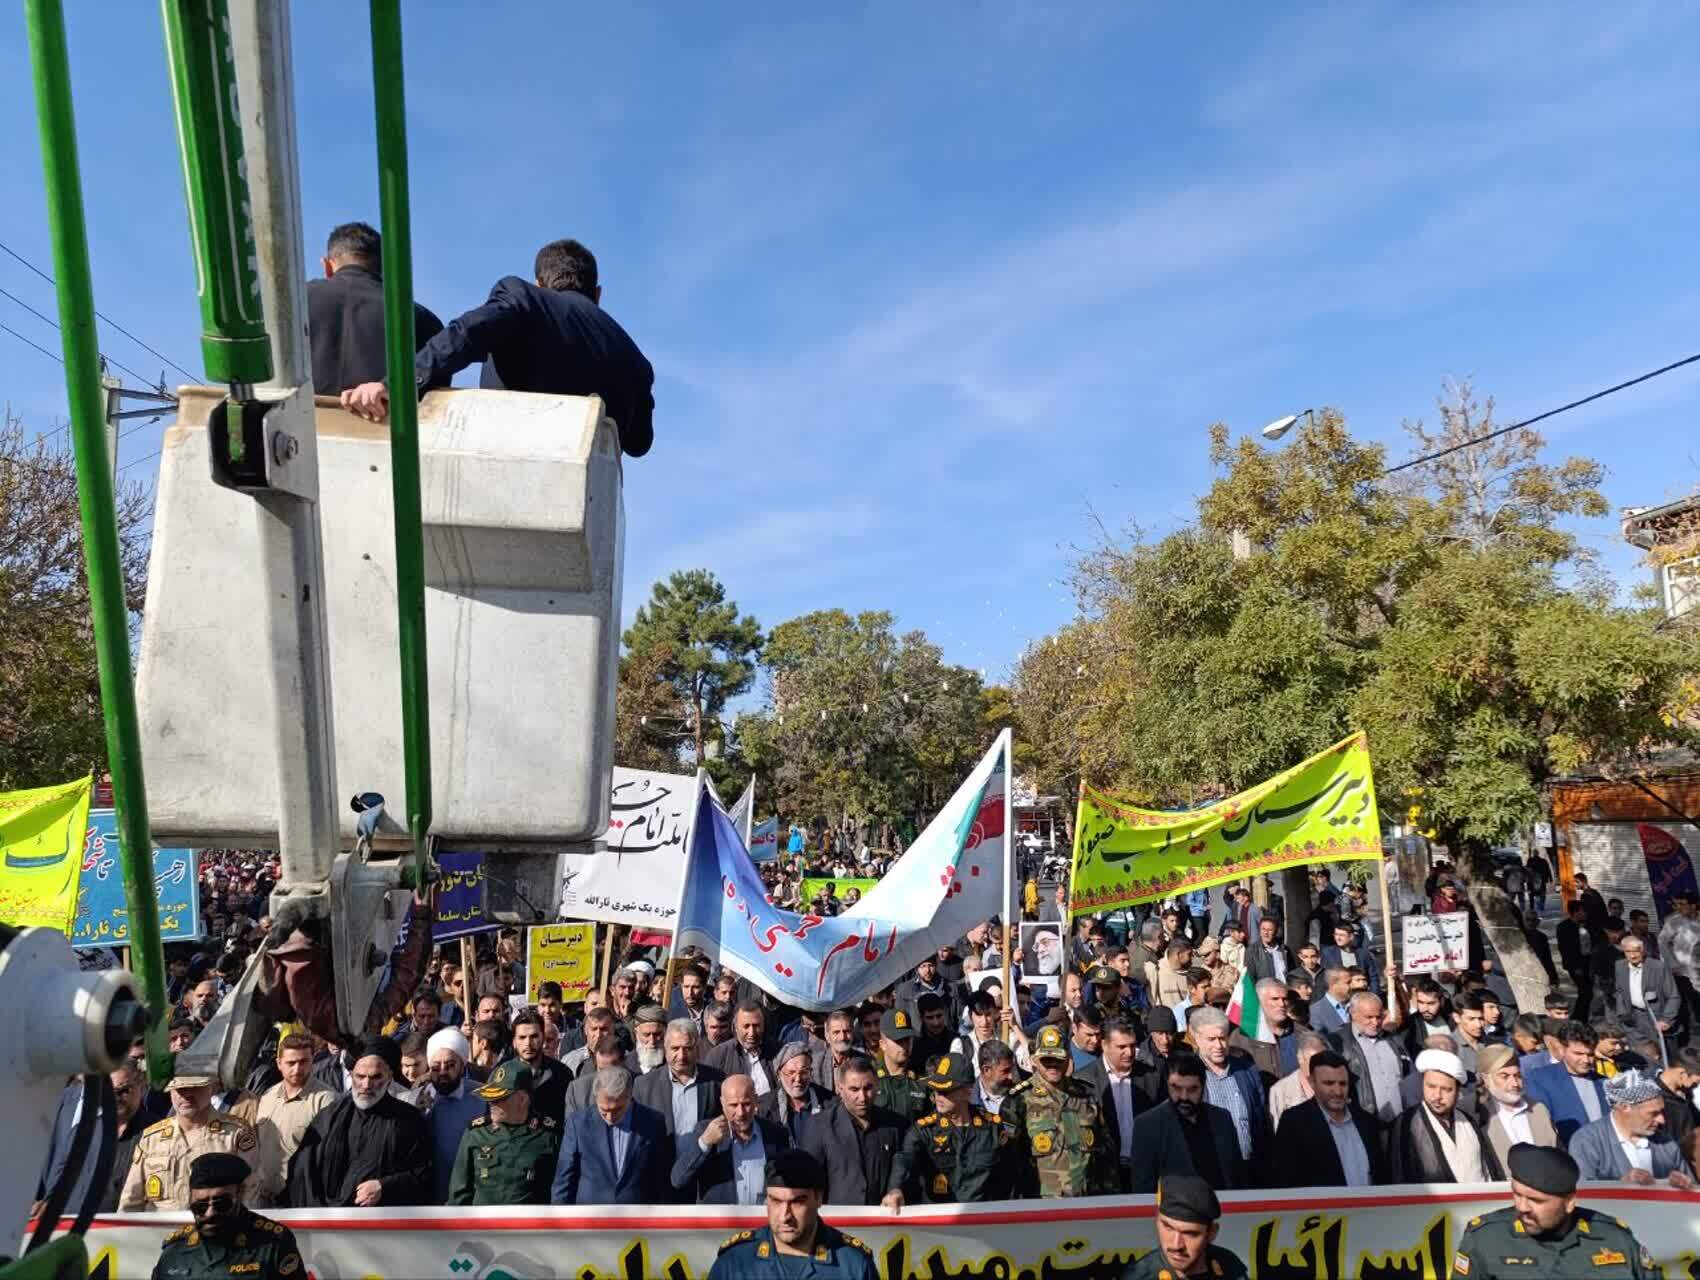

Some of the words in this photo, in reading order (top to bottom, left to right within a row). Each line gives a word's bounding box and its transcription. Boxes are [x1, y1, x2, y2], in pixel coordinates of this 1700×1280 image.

[1221, 771, 1370, 842] دبیرستان
[611, 901, 636, 912] شهری
[638, 904, 653, 913] یک
[655, 907, 677, 919] حوزه
[540, 931, 583, 948] دبیرستان
[817, 919, 897, 1000] امام
[229, 1262, 261, 1273] POLICE
